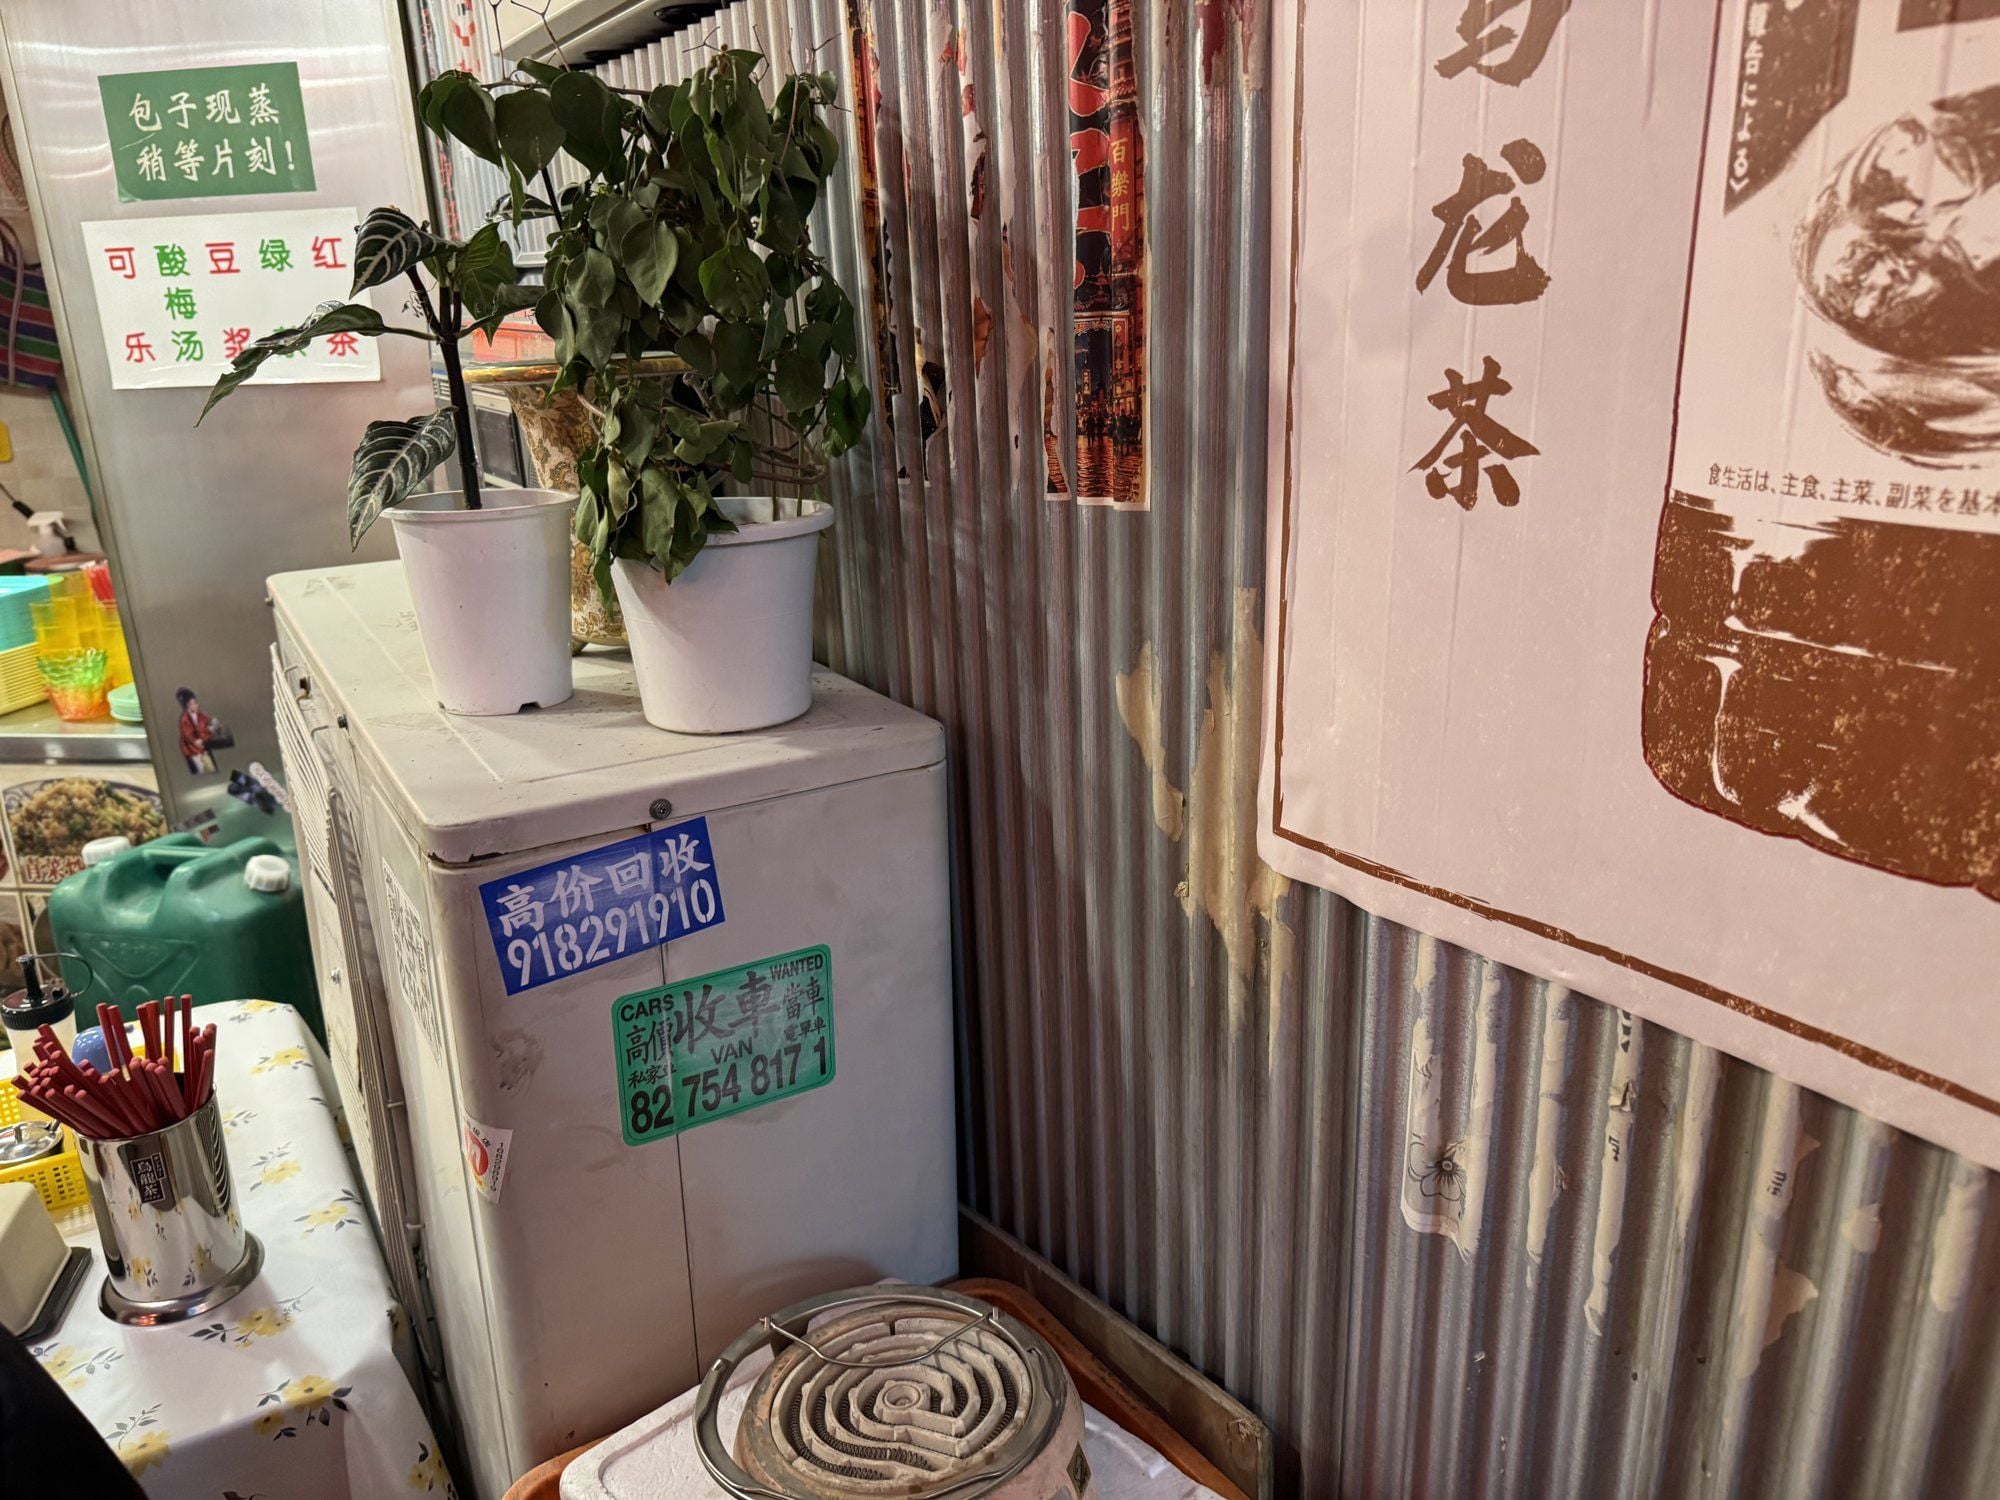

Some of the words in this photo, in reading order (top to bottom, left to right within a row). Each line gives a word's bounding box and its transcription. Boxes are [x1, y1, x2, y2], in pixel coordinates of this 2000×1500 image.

[129, 82, 279, 131] 包子现蒸
[1110, 137, 1130, 231] 百樂門
[153, 243, 204, 362] 酸梅汤
[497, 833, 711, 937] 高价回收
[507, 878, 716, 987] 918291910
[770, 954, 824, 981] WANTED
[621, 993, 675, 1022] CARS
[711, 1036, 753, 1065] VAN
